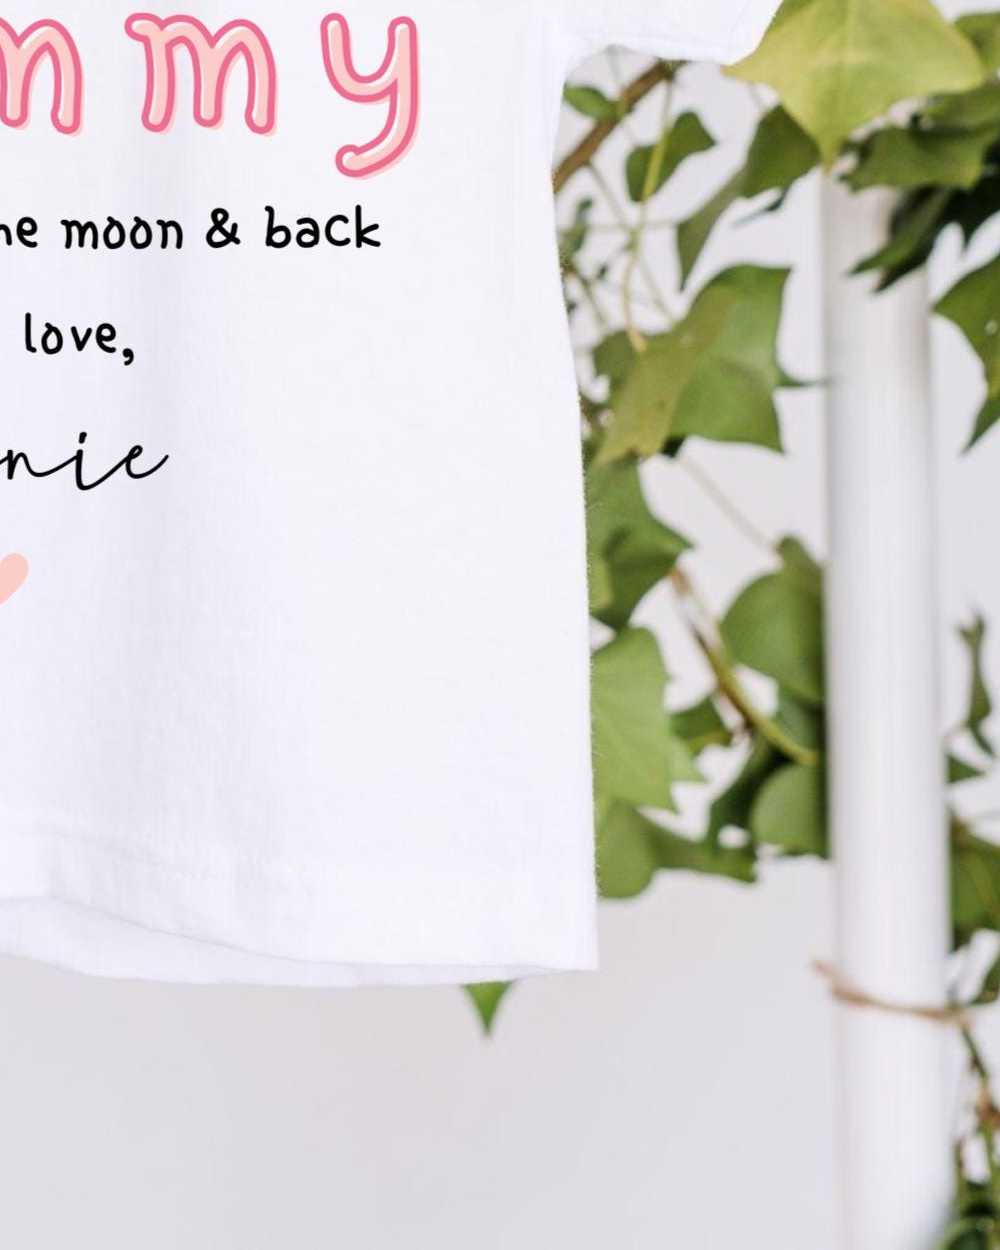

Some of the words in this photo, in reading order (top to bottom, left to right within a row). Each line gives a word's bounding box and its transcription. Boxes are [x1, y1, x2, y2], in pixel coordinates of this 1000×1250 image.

[59, 215, 184, 251] moon
[205, 207, 242, 249] &
[263, 204, 382, 249] back
[24, 311, 135, 367] love,
